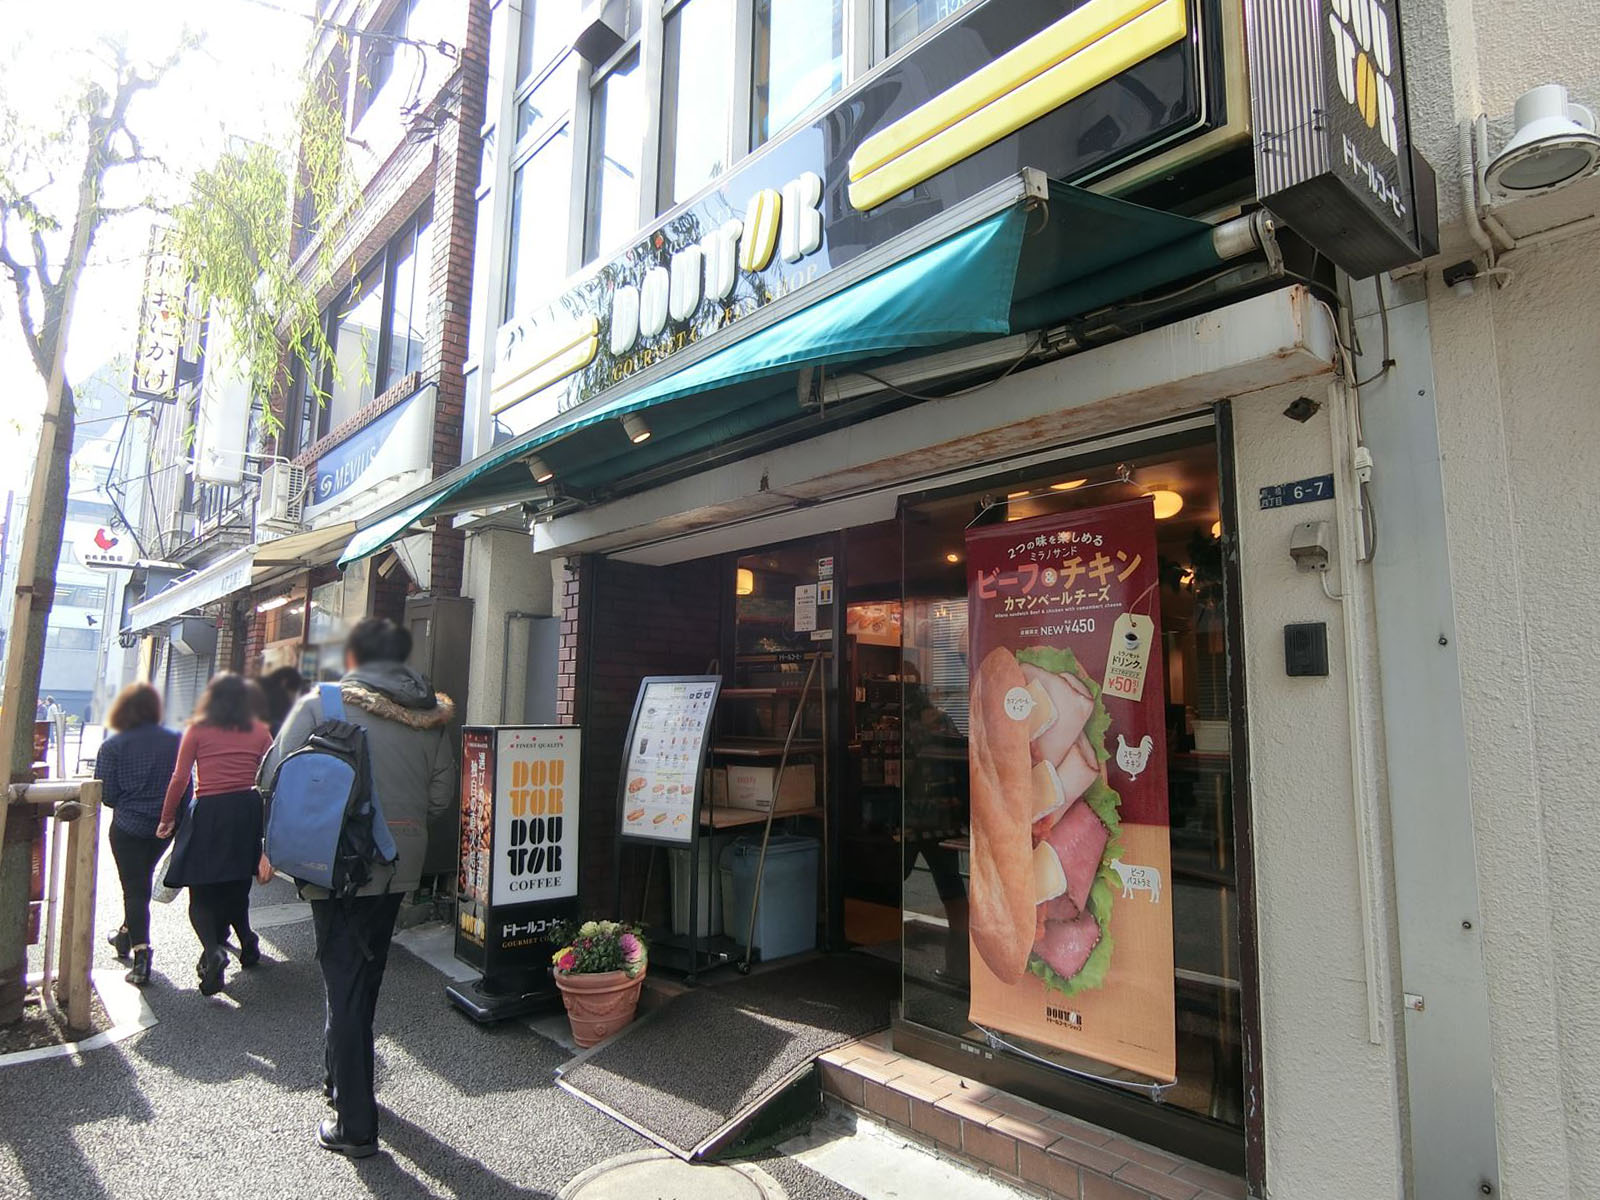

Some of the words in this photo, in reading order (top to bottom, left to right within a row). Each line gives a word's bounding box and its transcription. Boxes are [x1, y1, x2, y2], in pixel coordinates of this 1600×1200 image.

[1332, 0, 1391, 77] OU
[610, 170, 824, 358] DOUTOR
[1294, 481, 1324, 499] 6-7
[1007, 530, 1104, 560] 2つの味を楽しめる
[1030, 545, 1078, 562] ミラノサンド
[1004, 584, 1112, 612] カマンベールチーズ
[1040, 624, 1065, 637] NEW
[512, 759, 565, 789] DOU
[510, 816, 563, 847] DOU
[507, 845, 562, 876] TOR
[1130, 867, 1146, 877] ビーフ
[509, 876, 562, 892] COFFEE
